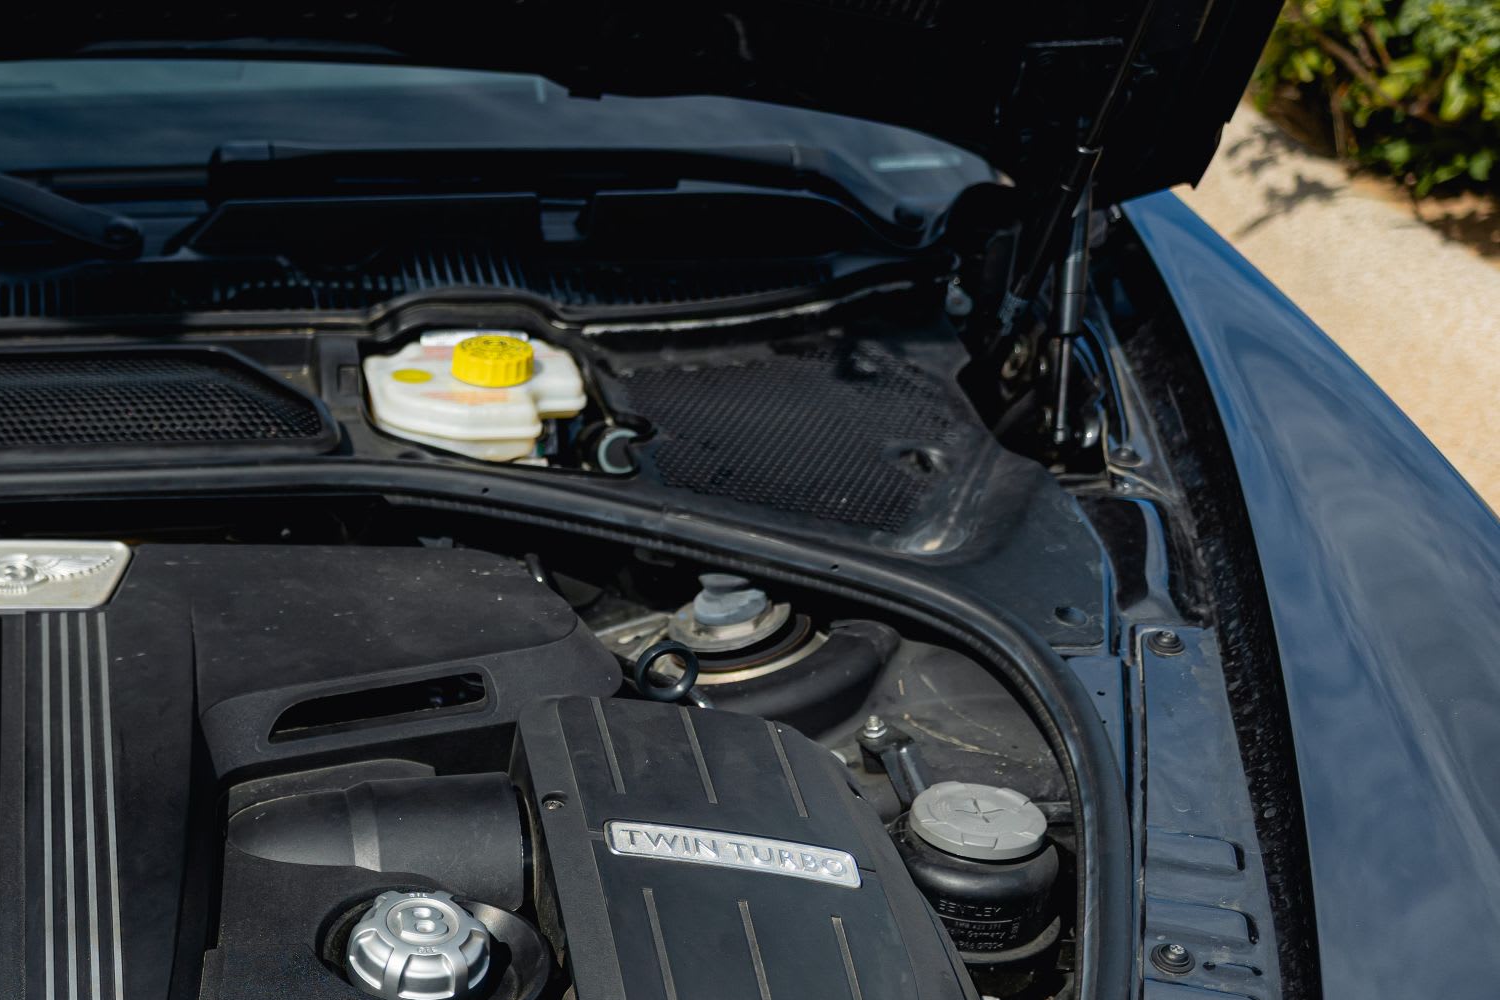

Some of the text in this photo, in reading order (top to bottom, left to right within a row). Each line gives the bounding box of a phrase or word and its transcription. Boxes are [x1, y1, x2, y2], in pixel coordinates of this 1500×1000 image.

[619, 829, 846, 877] TWIN TURBO
[396, 906, 449, 940] B
